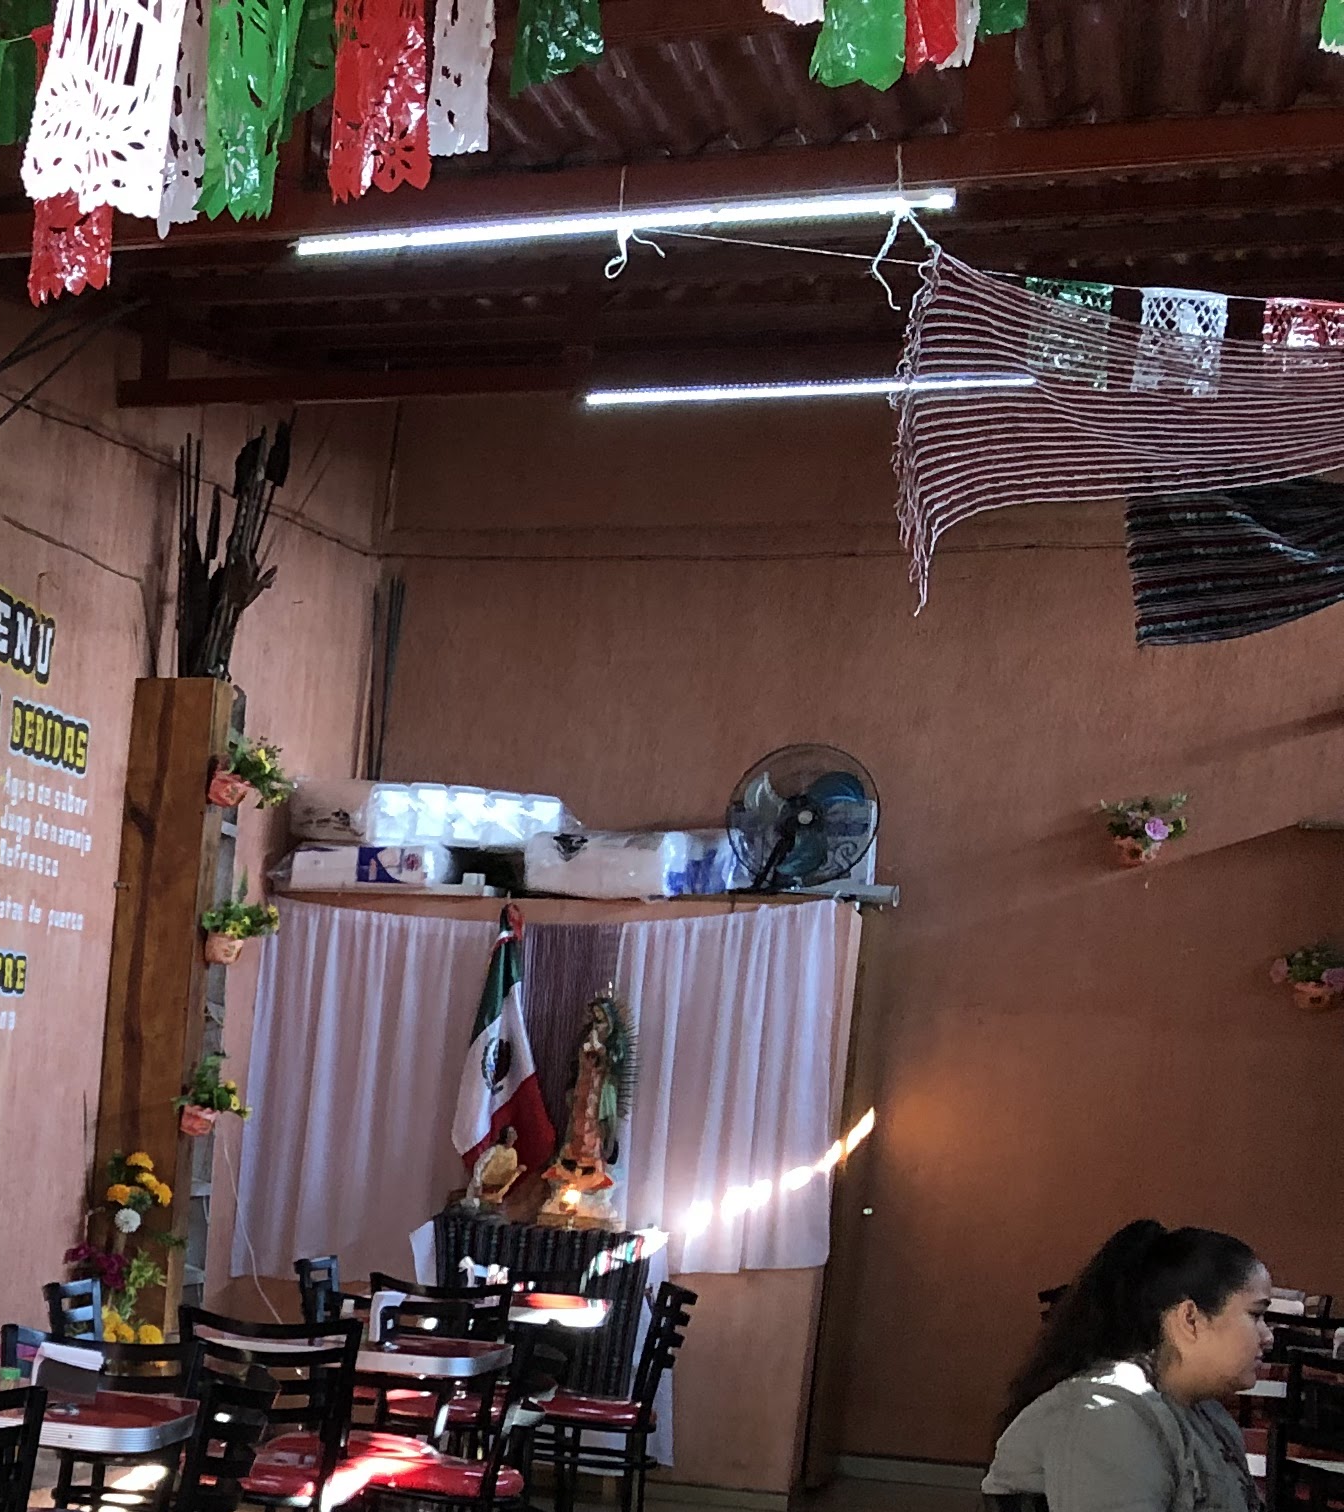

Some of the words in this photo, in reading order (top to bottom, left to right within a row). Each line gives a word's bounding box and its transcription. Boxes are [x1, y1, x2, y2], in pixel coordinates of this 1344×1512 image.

[10, 706, 89, 769] BEBIDAS
[37, 784, 51, 806] de
[54, 784, 88, 816] sabor
[34, 813, 49, 840] de
